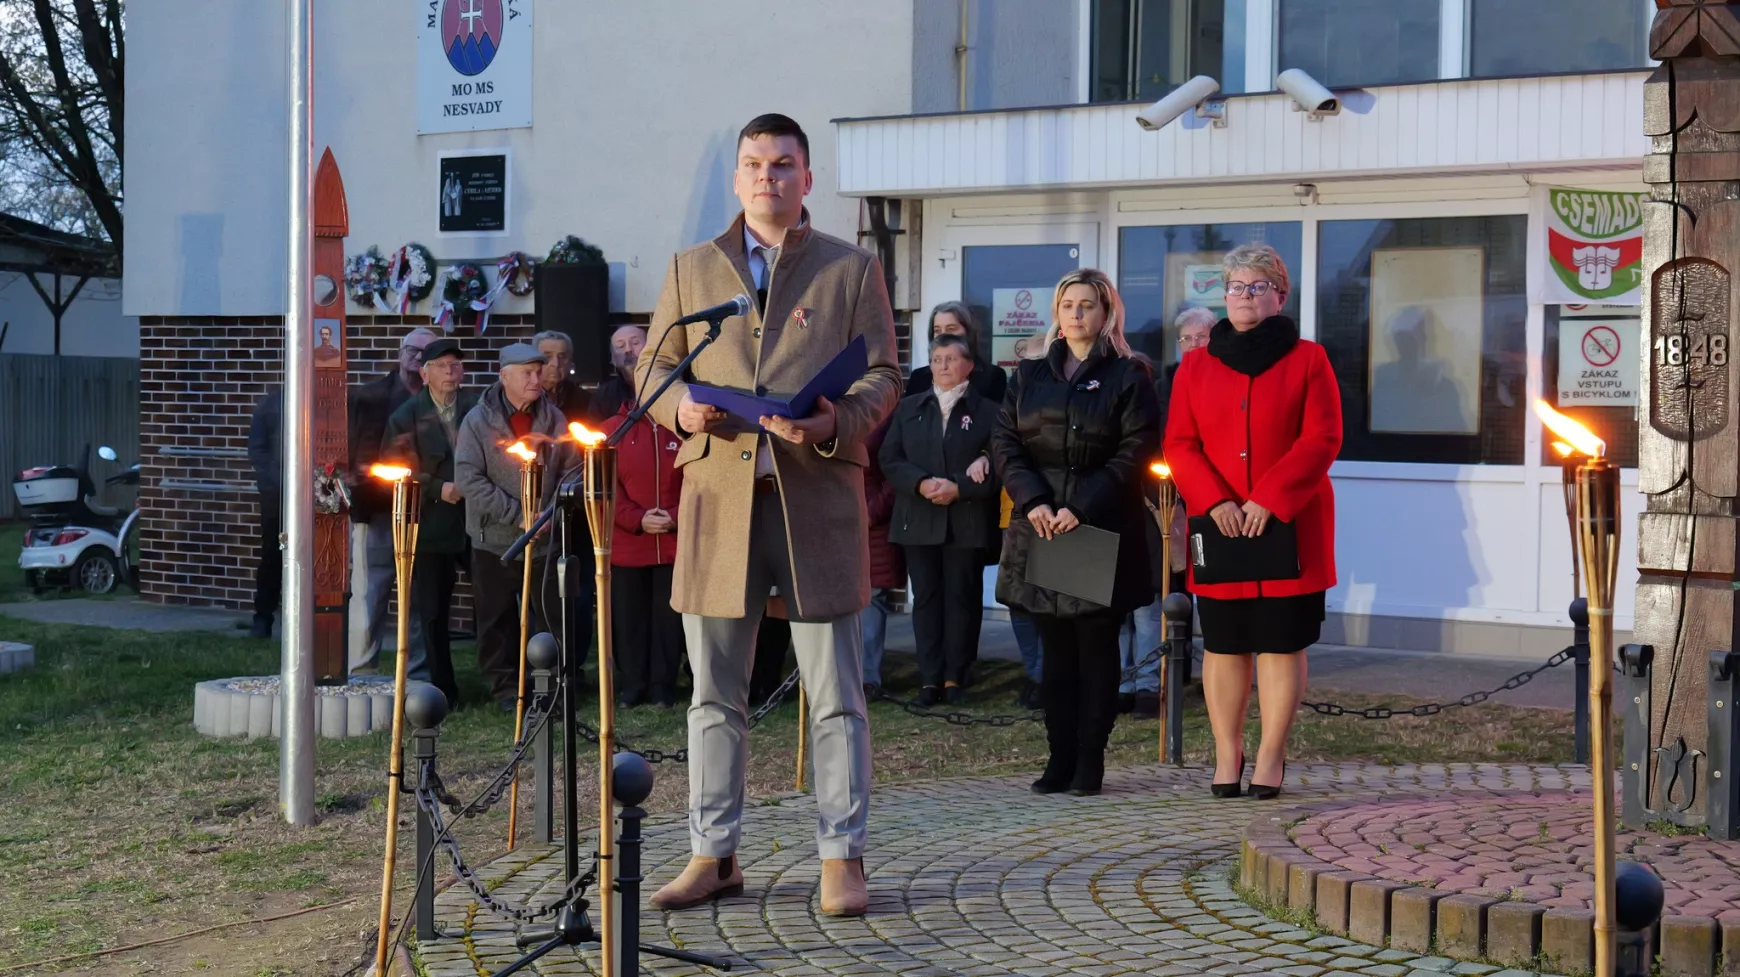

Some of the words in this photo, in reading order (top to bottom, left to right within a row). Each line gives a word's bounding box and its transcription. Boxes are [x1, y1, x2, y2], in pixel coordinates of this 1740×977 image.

[452, 83, 472, 96] MO
[475, 81, 494, 95] MS
[443, 100, 503, 117] NESVADY
[1654, 334, 1728, 367] 1848
[1581, 369, 1619, 379] ZÁKAZ
[1578, 381, 1622, 389] VSTUPU
[1562, 391, 1570, 399] S
[1572, 390, 1631, 399] BICYKLOM
